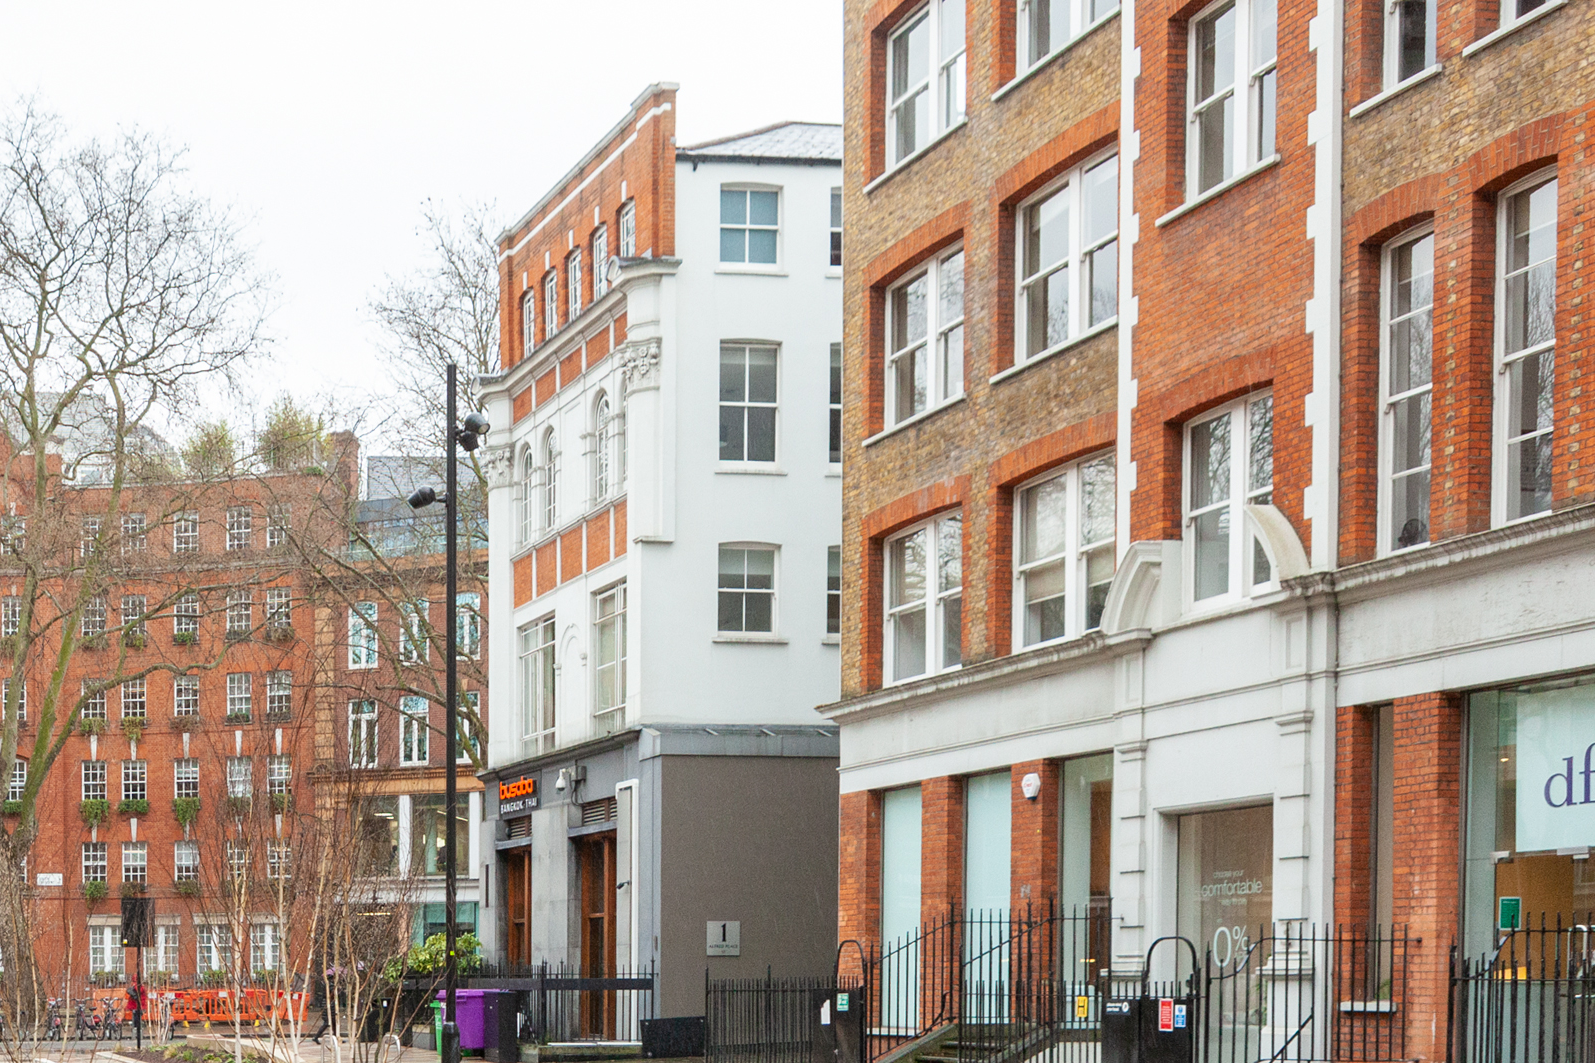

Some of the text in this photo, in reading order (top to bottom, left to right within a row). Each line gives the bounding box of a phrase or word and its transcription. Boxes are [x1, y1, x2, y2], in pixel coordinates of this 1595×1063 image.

[499, 775, 534, 800] busaba
[1201, 878, 1263, 897] comfortable
[721, 922, 727, 942] 1
[1213, 925, 1249, 968] 0%
